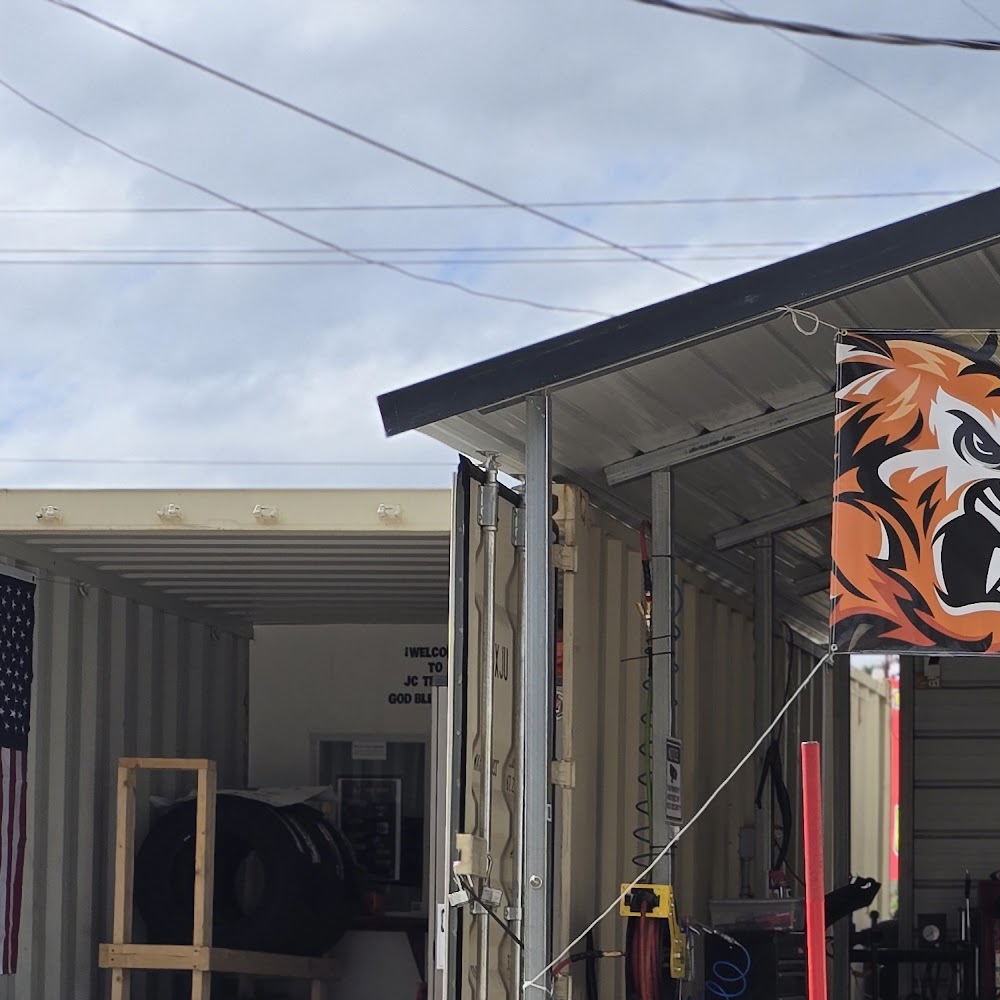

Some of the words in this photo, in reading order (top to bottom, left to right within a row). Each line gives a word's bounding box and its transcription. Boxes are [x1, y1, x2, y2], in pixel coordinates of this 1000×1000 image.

[428, 662, 443, 673] TO
[403, 675, 418, 687] JC
[388, 693, 412, 704] GOD
